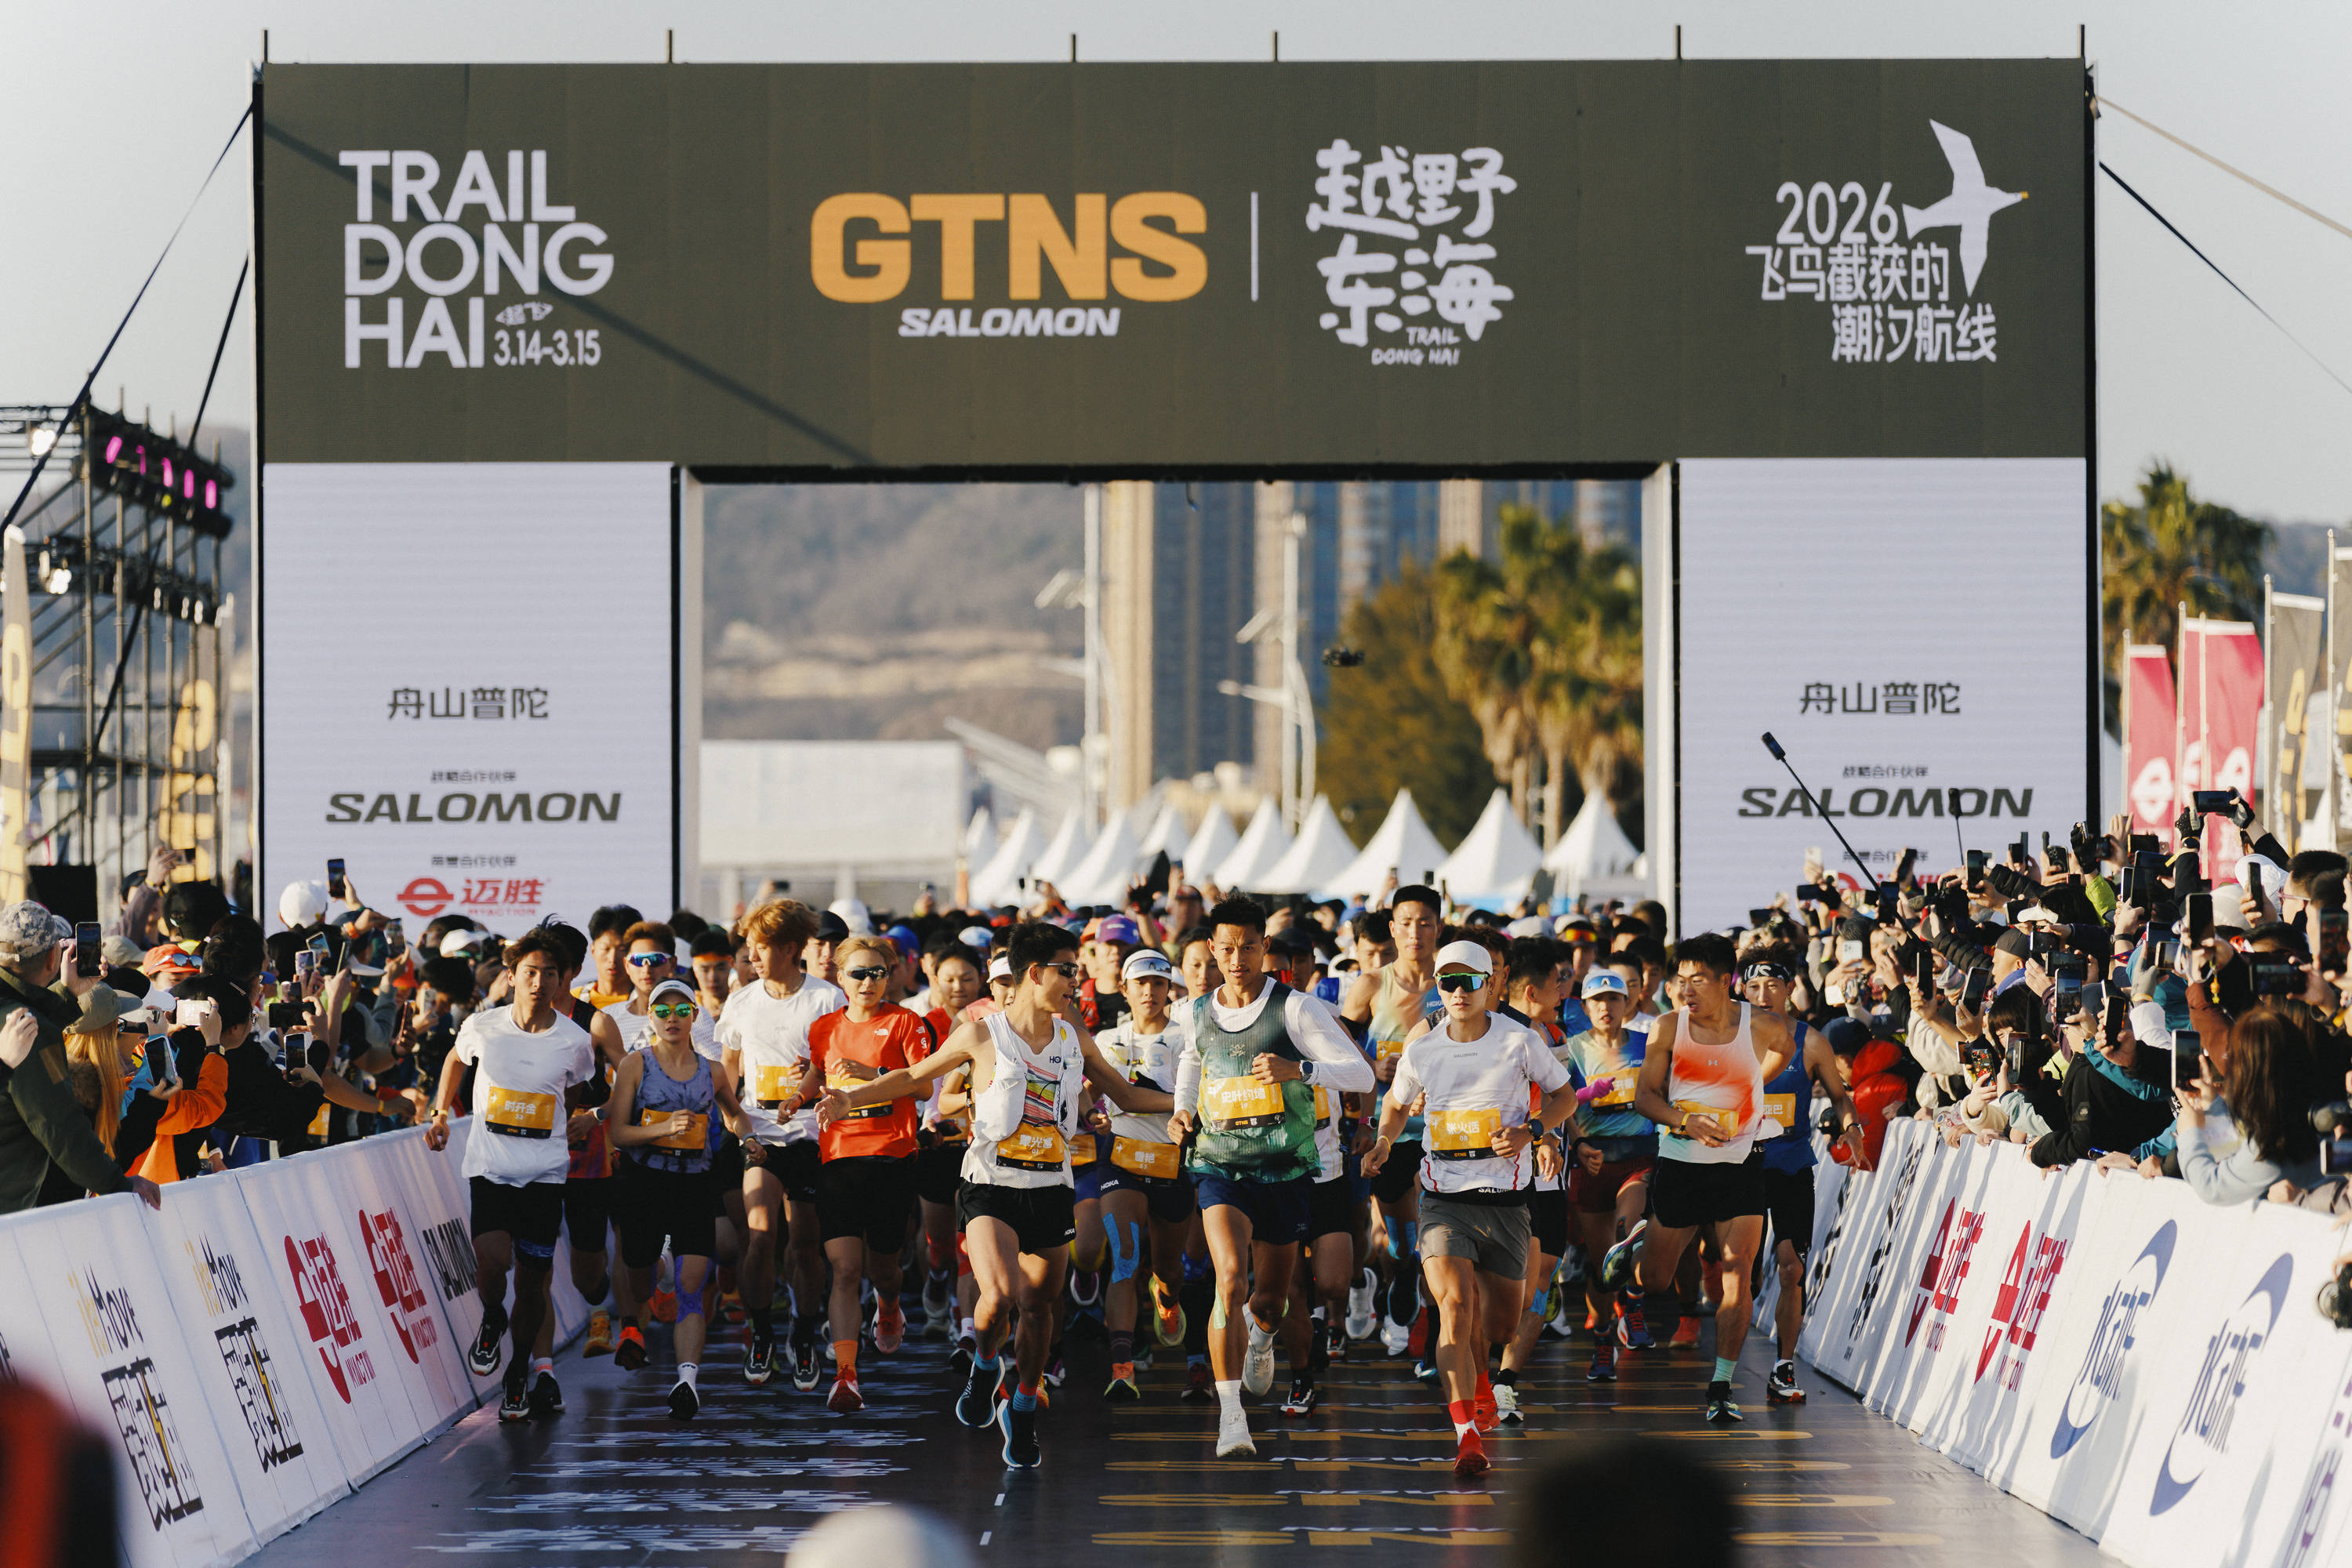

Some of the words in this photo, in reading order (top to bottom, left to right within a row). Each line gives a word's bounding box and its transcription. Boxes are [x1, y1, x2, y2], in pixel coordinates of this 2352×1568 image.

[339, 150, 576, 222] TRAIL
[1305, 138, 1518, 238] 越野
[1776, 181, 1899, 245] 2026
[344, 223, 614, 296] DONG
[810, 191, 1208, 303] GTNS
[1745, 242, 1949, 302] 飞鸟截获的
[1316, 234, 1515, 346] 东海
[345, 297, 485, 368] HAI
[493, 329, 601, 366] 3.14-3.15
[898, 307, 1120, 337] SALOMON
[1406, 326, 1461, 346] TRAIL
[1831, 303, 1997, 363] 潮汐航线
[1371, 347, 1425, 365] DONG
[1428, 347, 1461, 366] HAI
[388, 687, 549, 720] 舟山普陀
[1800, 682, 1962, 715] 舟山普陀
[325, 793, 621, 822] SALOMON
[1738, 788, 2033, 817] SALOMON
[460, 878, 545, 905] 迈胜
[1101, 1179, 1120, 1191] HOKA
[300, 1232, 362, 1347] 迈胜
[1931, 1207, 1985, 1315] 迈胜
[2005, 1232, 2065, 1352] 迈胜
